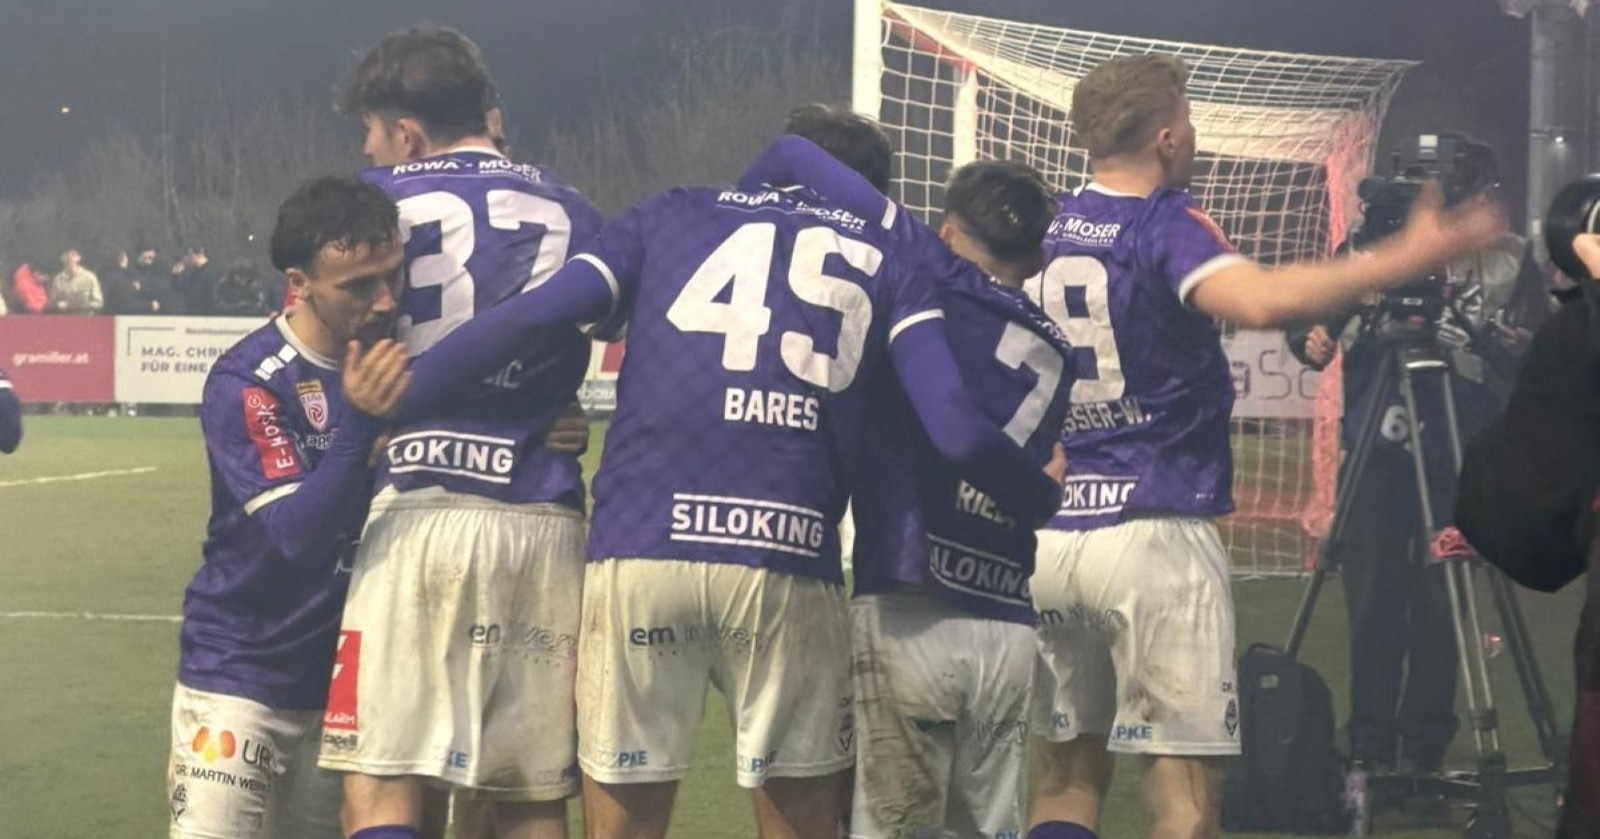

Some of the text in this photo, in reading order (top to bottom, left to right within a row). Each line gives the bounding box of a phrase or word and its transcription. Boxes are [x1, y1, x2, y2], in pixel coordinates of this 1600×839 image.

[796, 201, 867, 228] OSER
[1063, 218, 1121, 238] MOSER
[395, 190, 572, 358] 37
[666, 222, 883, 392] 45
[1023, 255, 1126, 403] 9
[141, 346, 180, 358] MAG.
[141, 360, 170, 373] FÜR
[995, 320, 1064, 447] 7
[724, 387, 819, 431] BARES
[387, 439, 514, 474] LOKING
[671, 503, 823, 548] SILOKING
[191, 767, 236, 786] MARTIN
